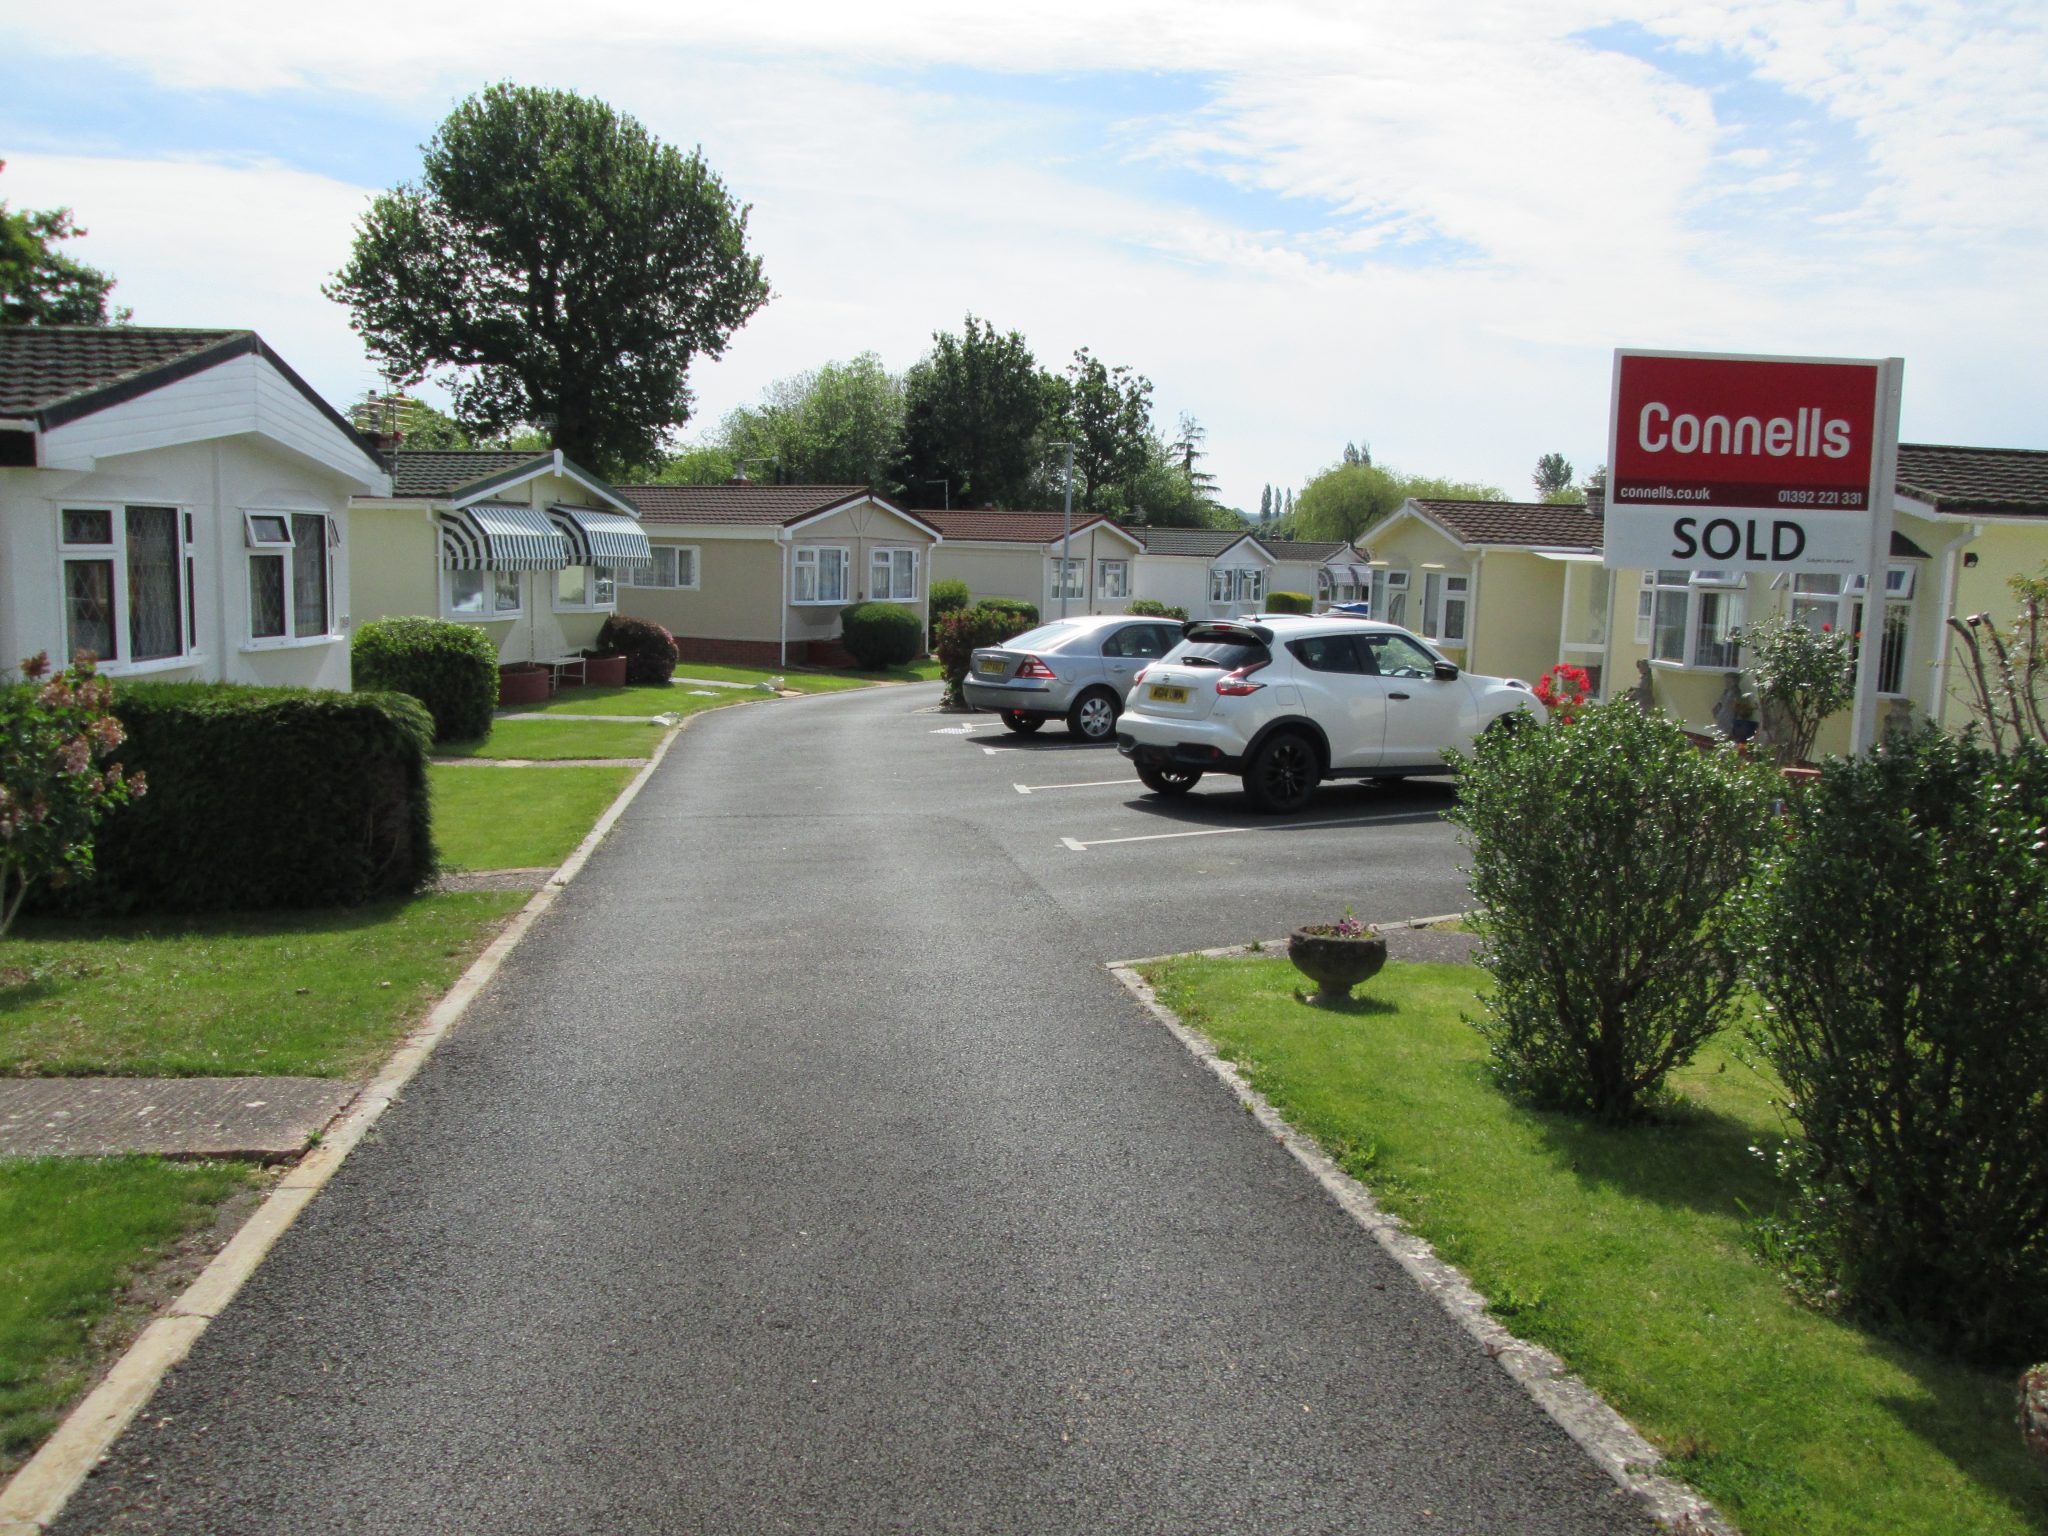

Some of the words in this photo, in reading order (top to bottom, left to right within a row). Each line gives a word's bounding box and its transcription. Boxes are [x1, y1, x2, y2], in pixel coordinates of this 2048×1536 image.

[1639, 402, 1850, 458] Connells
[1620, 486, 1710, 500] connells.co.uk
[1778, 490, 1815, 504] 01392
[1818, 491, 1839, 505] 221
[1841, 492, 1862, 505] 331
[1672, 517, 1805, 561] SOLD
